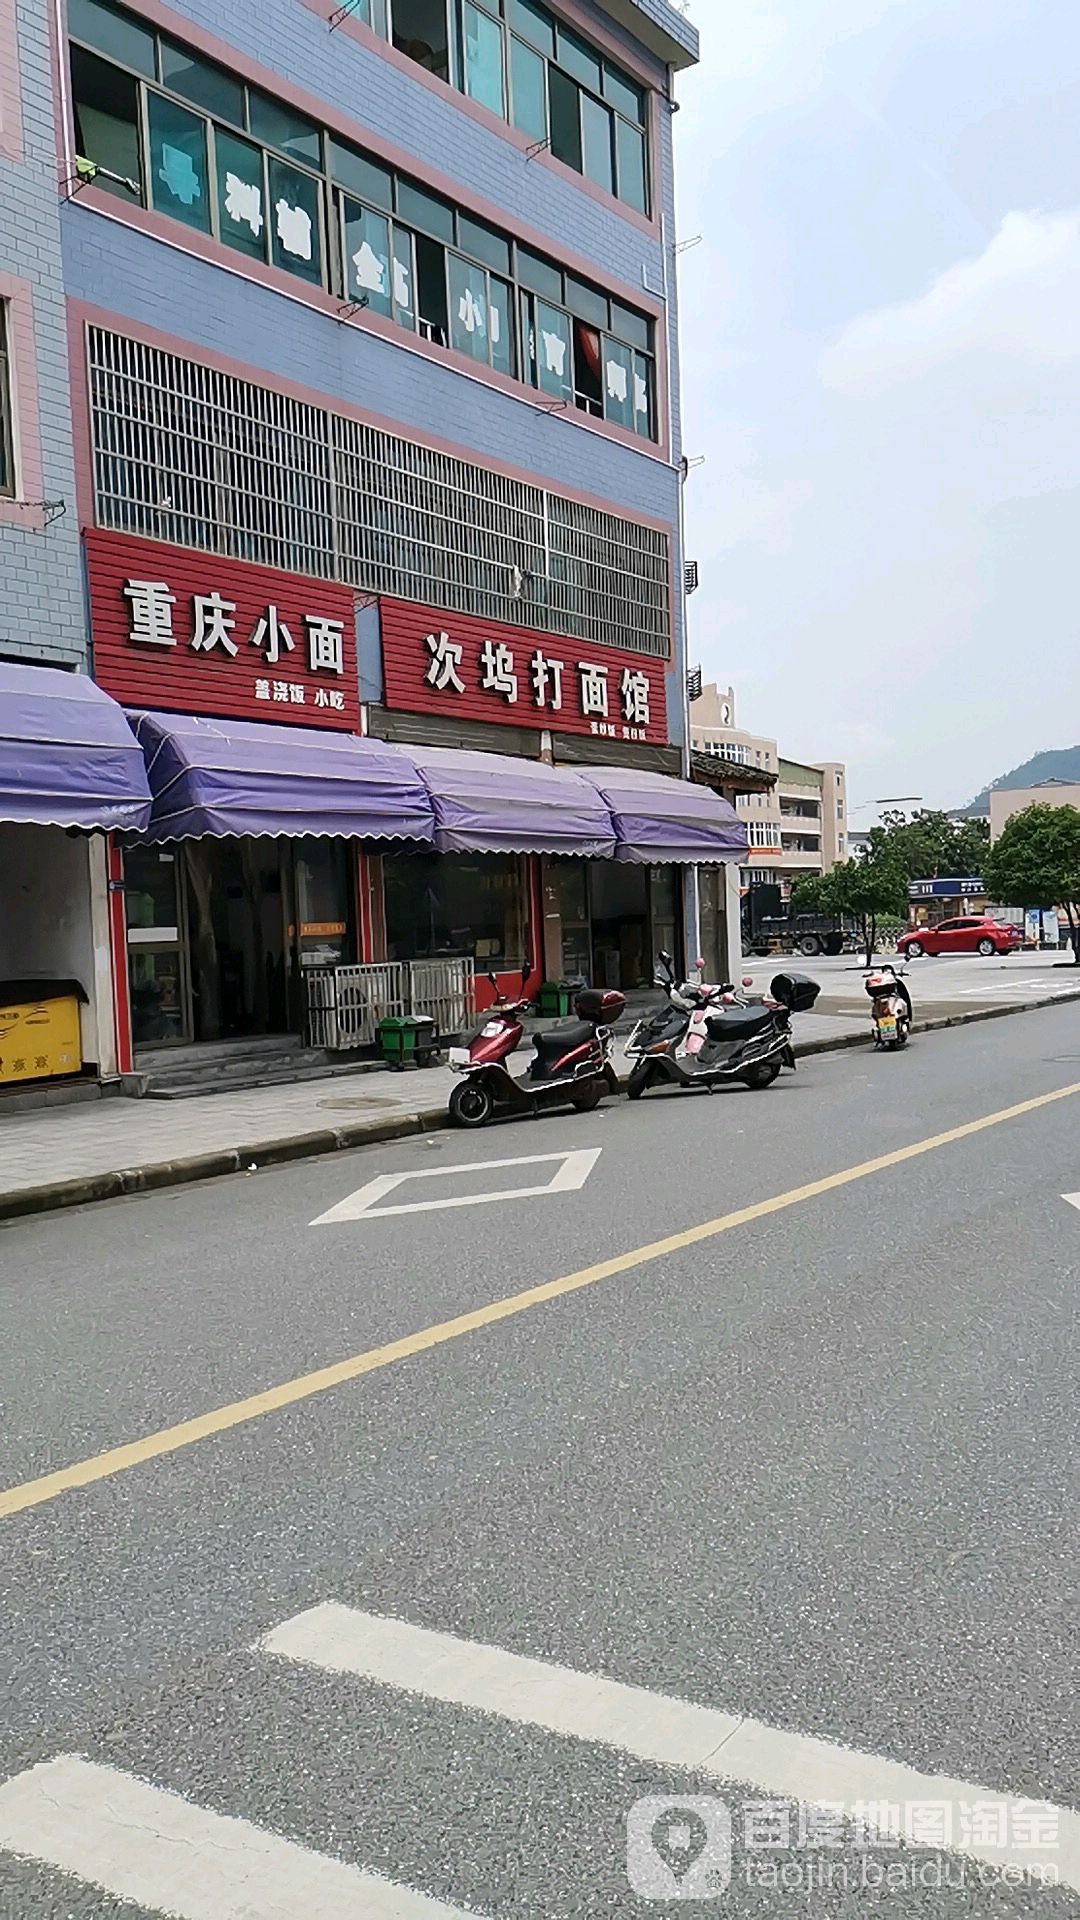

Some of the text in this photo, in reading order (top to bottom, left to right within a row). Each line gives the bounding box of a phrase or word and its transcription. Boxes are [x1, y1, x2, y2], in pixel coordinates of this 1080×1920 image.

[123, 578, 345, 675] 重庆小面
[255, 678, 345, 710] 盖浇饭 小吃
[426, 631, 650, 725] 次坞打面馆
